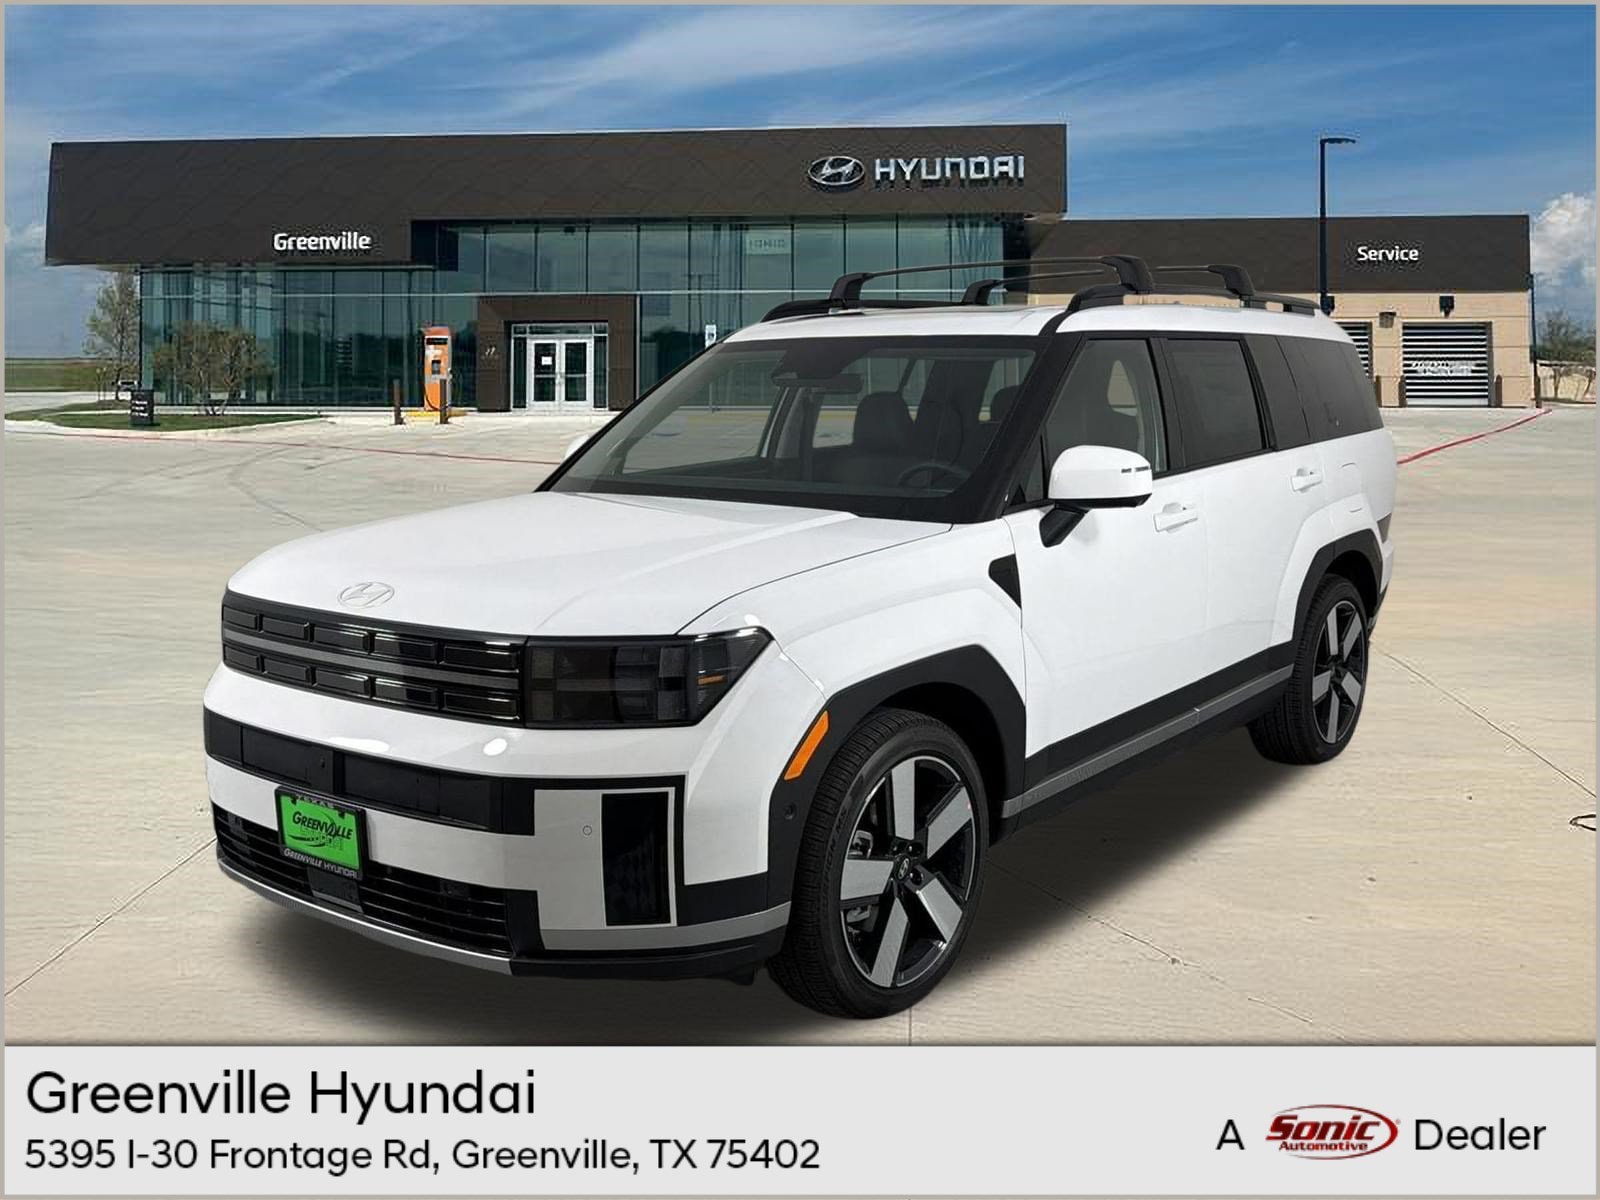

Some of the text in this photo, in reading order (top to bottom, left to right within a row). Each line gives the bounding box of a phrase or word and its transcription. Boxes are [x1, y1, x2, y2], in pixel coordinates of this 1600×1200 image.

[874, 155, 1025, 181] HYUNDAI
[273, 231, 372, 251] Greenville
[1356, 245, 1419, 261] Service
